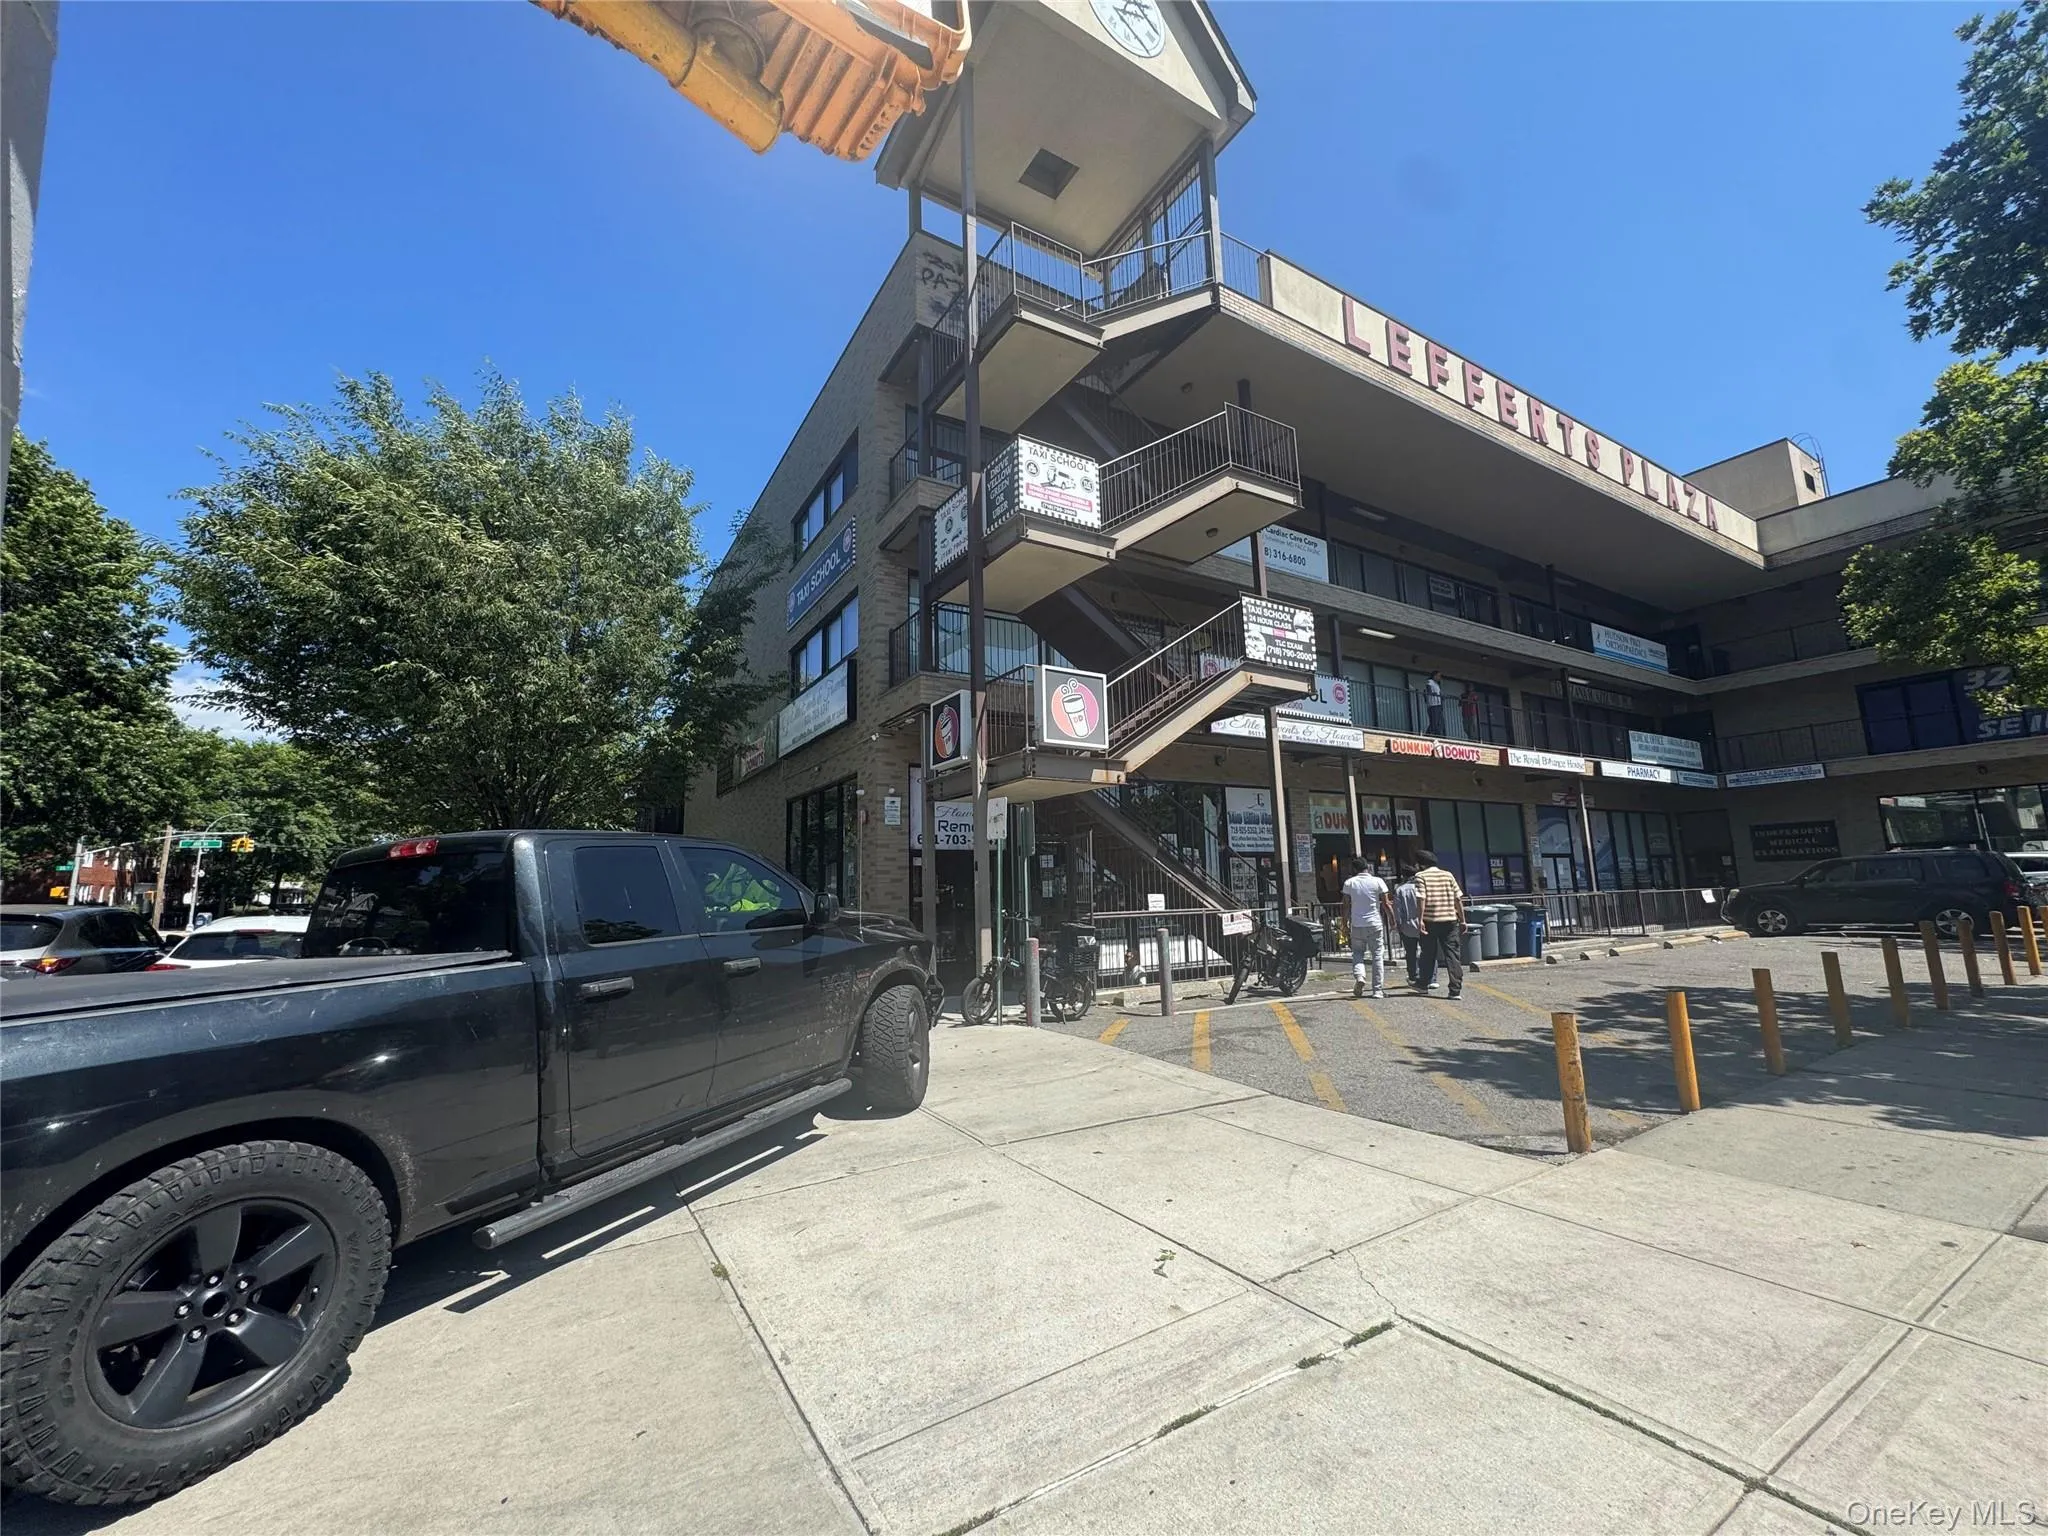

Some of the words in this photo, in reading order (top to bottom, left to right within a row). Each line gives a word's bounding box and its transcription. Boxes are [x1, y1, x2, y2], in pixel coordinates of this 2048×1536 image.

[1342, 295, 1601, 471] LEFFERTS
[1619, 447, 1720, 531] PLAZA
[990, 456, 1009, 479] DRIVE
[1028, 446, 1048, 459] TAXI
[1050, 454, 1089, 473] SCHOOL
[987, 464, 1013, 491] YELLOW
[989, 477, 1011, 500] GREEN
[995, 493, 1005, 506] OR
[992, 500, 1009, 519] UBER
[1265, 527, 1288, 539] Cardiac
[1289, 533, 1303, 544] Care
[1303, 538, 1318, 549] Corp
[1273, 549, 1306, 566] 316-6800
[796, 584, 811, 607] TAXI
[810, 552, 841, 593] SCHOOL
[1247, 603, 1263, 613] TAXI
[1263, 608, 1293, 622] SCHOOL
[1257, 616, 1273, 626] HOUR
[1274, 621, 1292, 630] CLASS
[1267, 645, 1282, 657] (718)
[1282, 648, 1313, 661] 790-2000
[1286, 642, 1303, 651] EXAM
[1229, 716, 1261, 730] Elite
[1276, 724, 1301, 736] vents
[1302, 725, 1314, 737] &
[1316, 728, 1361, 744] Flowers
[1390, 739, 1433, 757] DUNKIN'
[1444, 747, 1481, 762] DONUTS
[1509, 754, 1522, 765] The
[1523, 754, 1541, 766] Royal
[1627, 766, 1661, 780] PHARMACY
[1754, 826, 1831, 838] INDEPENDENT
[1769, 837, 1819, 847] MEDICAL
[1754, 847, 1840, 857] EXAMINATIONS
